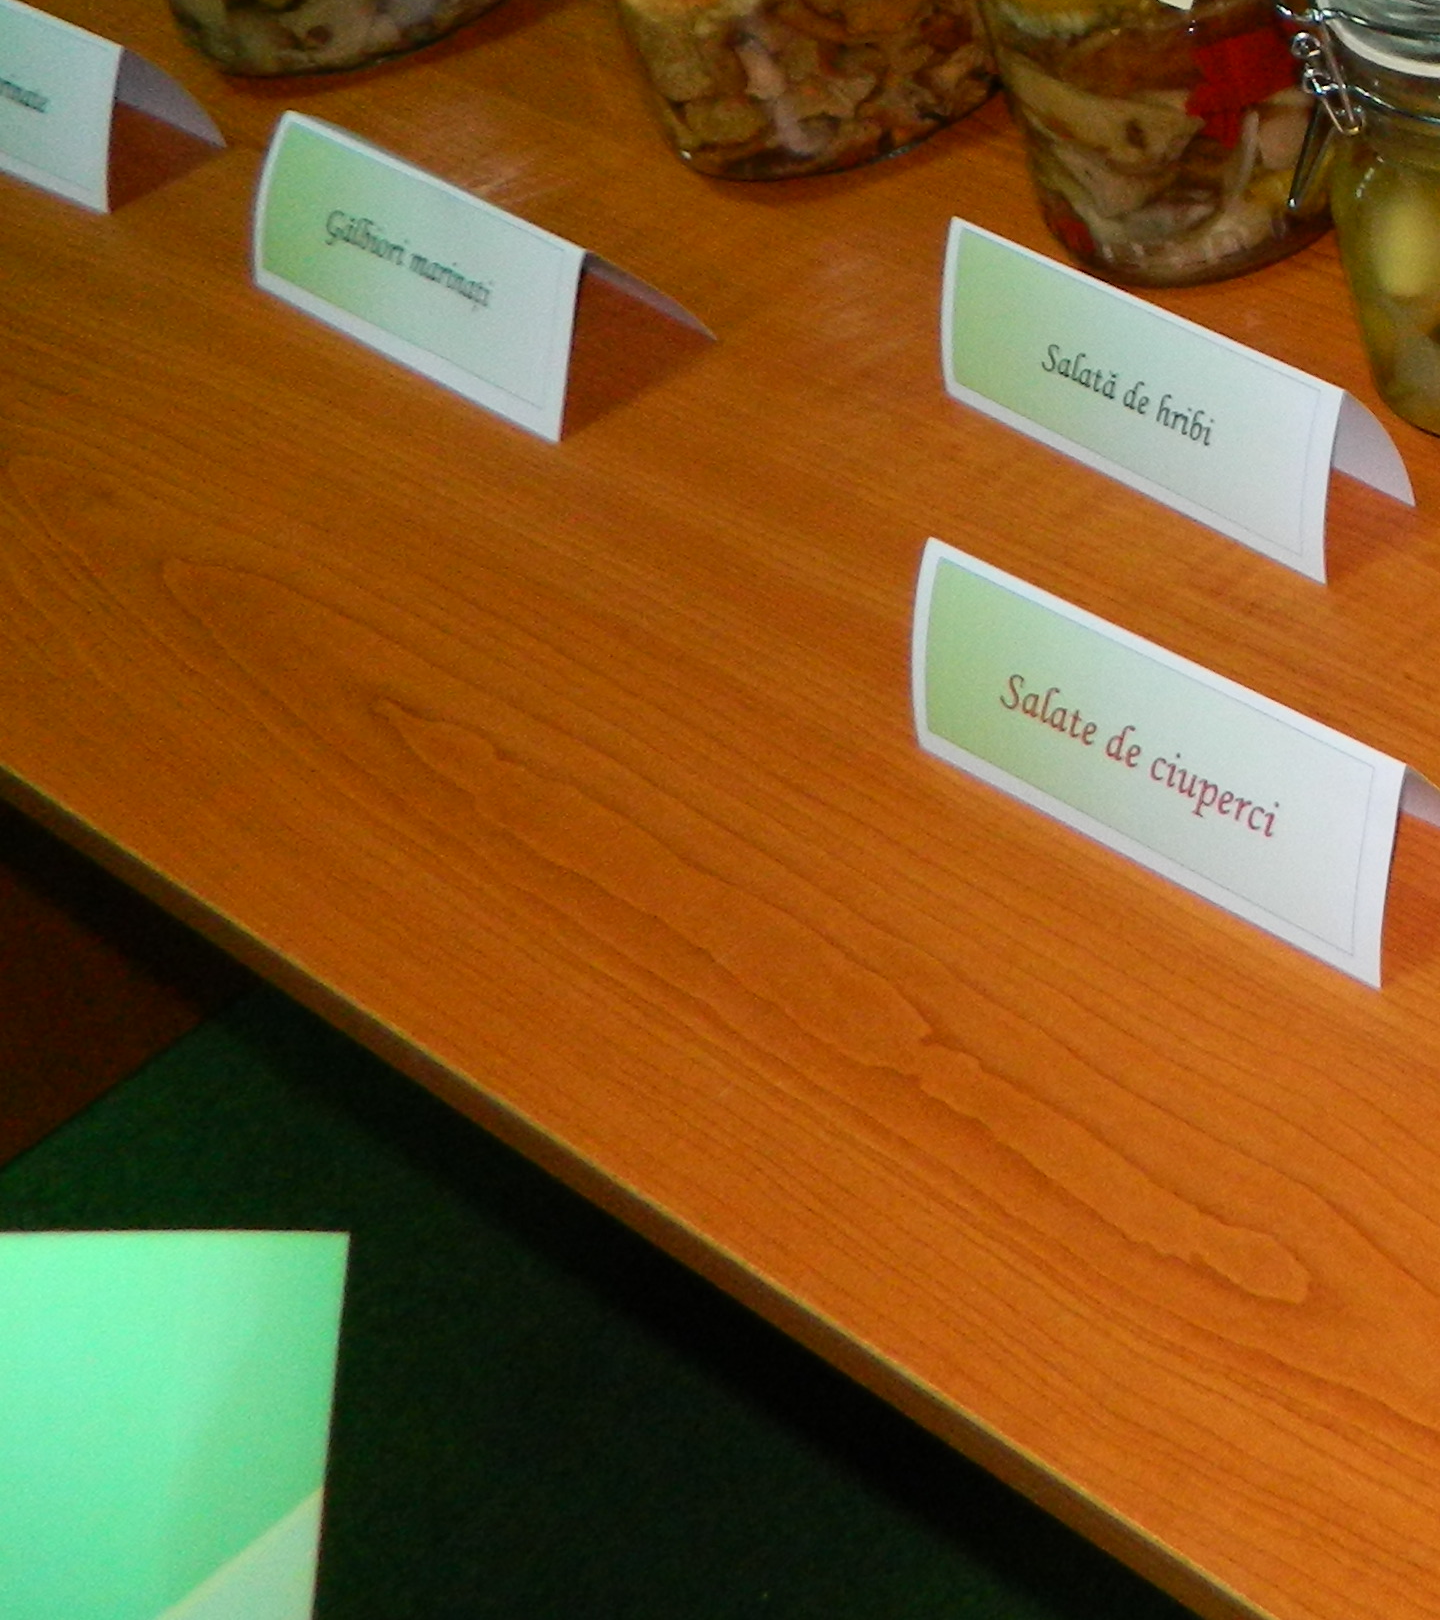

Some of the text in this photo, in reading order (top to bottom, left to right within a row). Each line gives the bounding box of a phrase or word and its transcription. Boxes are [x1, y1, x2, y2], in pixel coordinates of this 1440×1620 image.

[1041, 343, 1215, 448] Salată de hribi
[998, 673, 1281, 840] Salate de ciuperci
